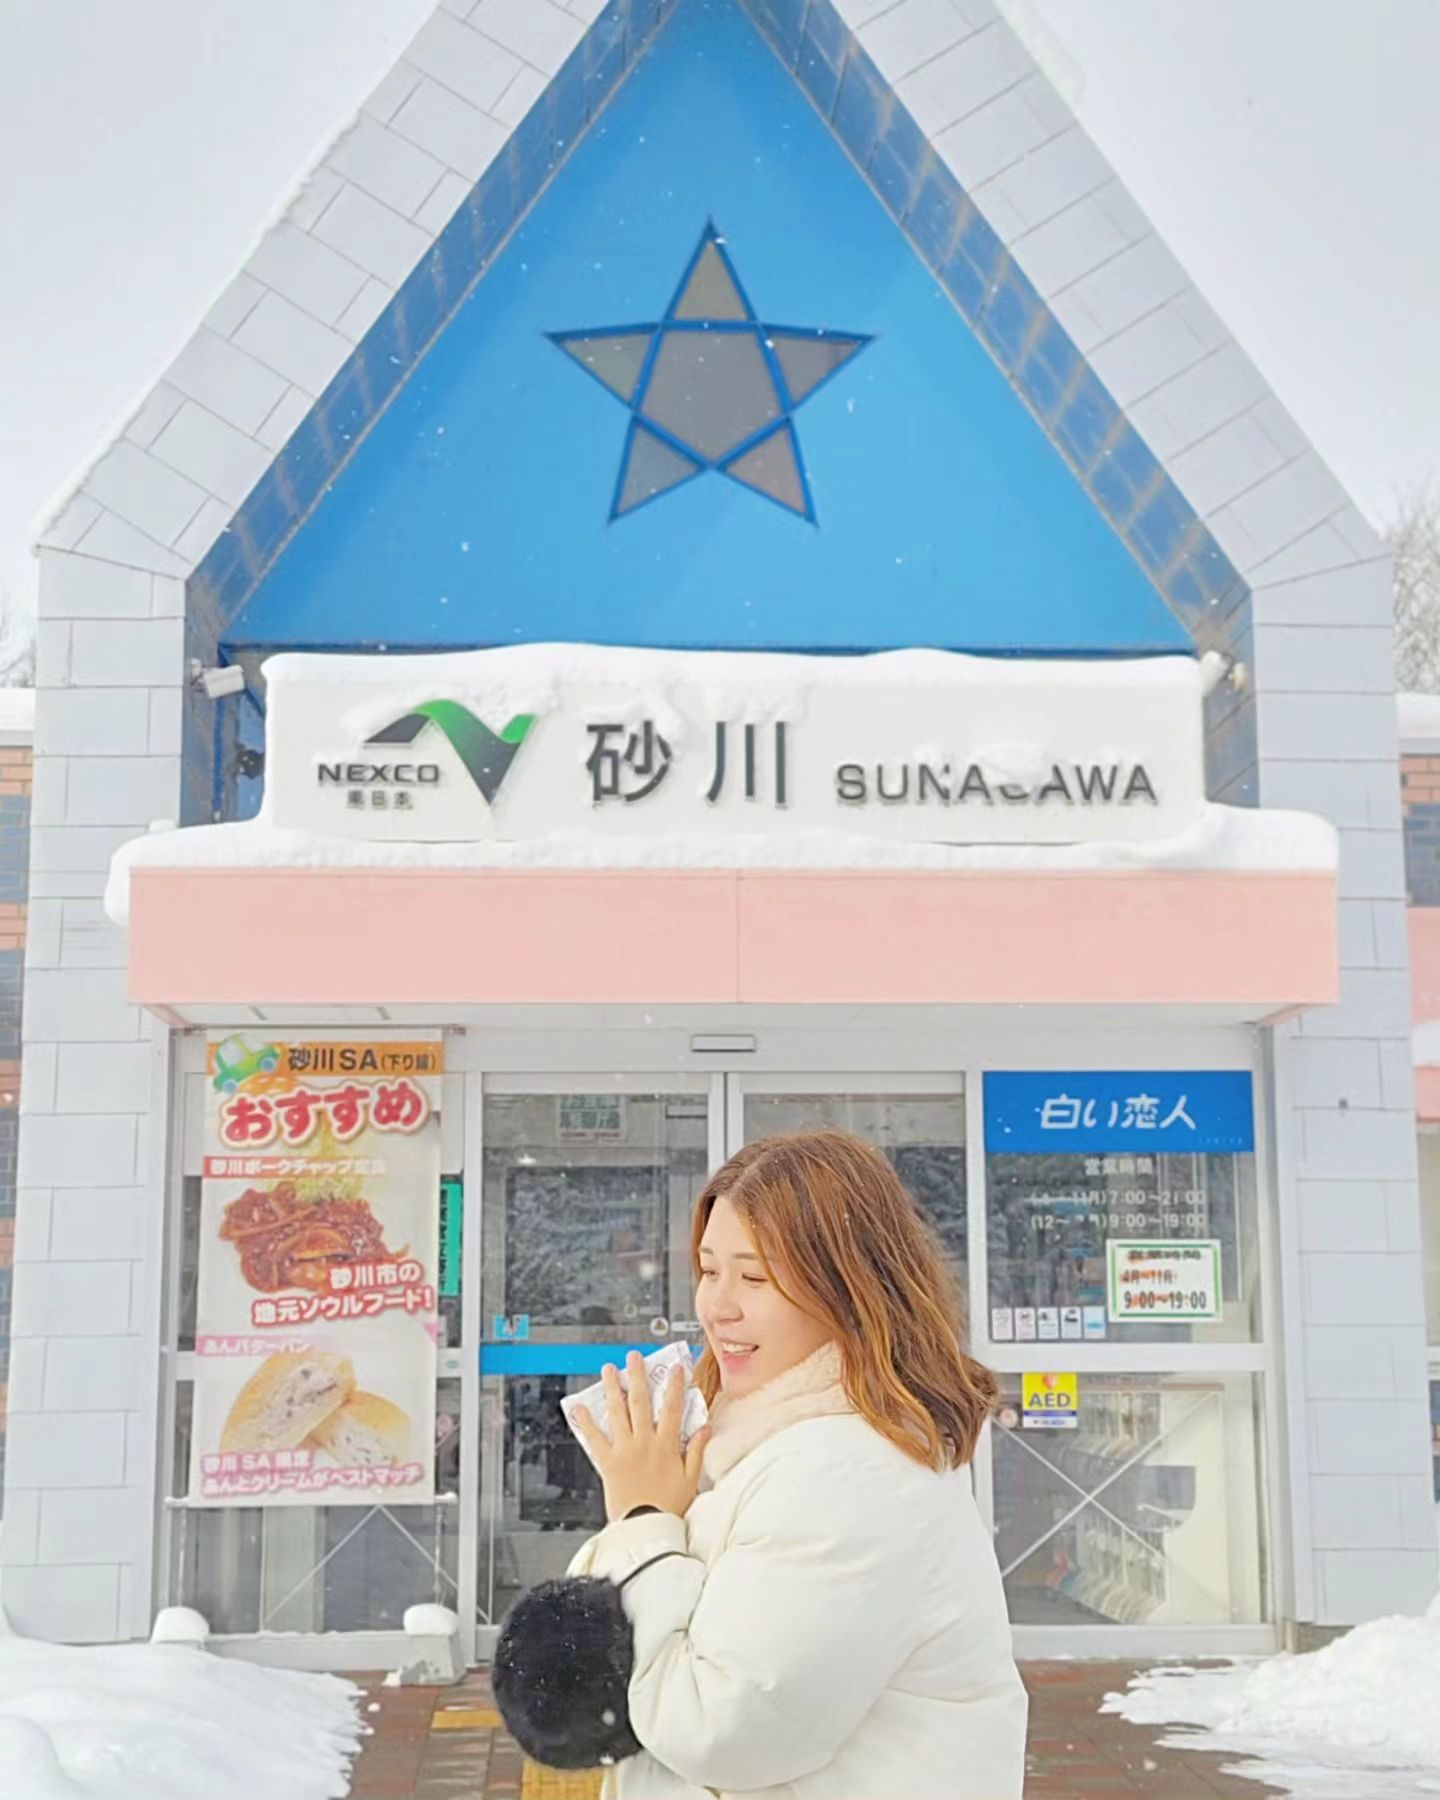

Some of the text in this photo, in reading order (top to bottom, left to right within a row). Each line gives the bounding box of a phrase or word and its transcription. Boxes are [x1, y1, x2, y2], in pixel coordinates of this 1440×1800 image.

[318, 763, 440, 783] NEXCO
[585, 719, 787, 807] 砂川
[223, 1080, 425, 1144] おすすめ
[1040, 1093, 1197, 1130] 白い恋人
[1028, 1392, 1072, 1408] AED
